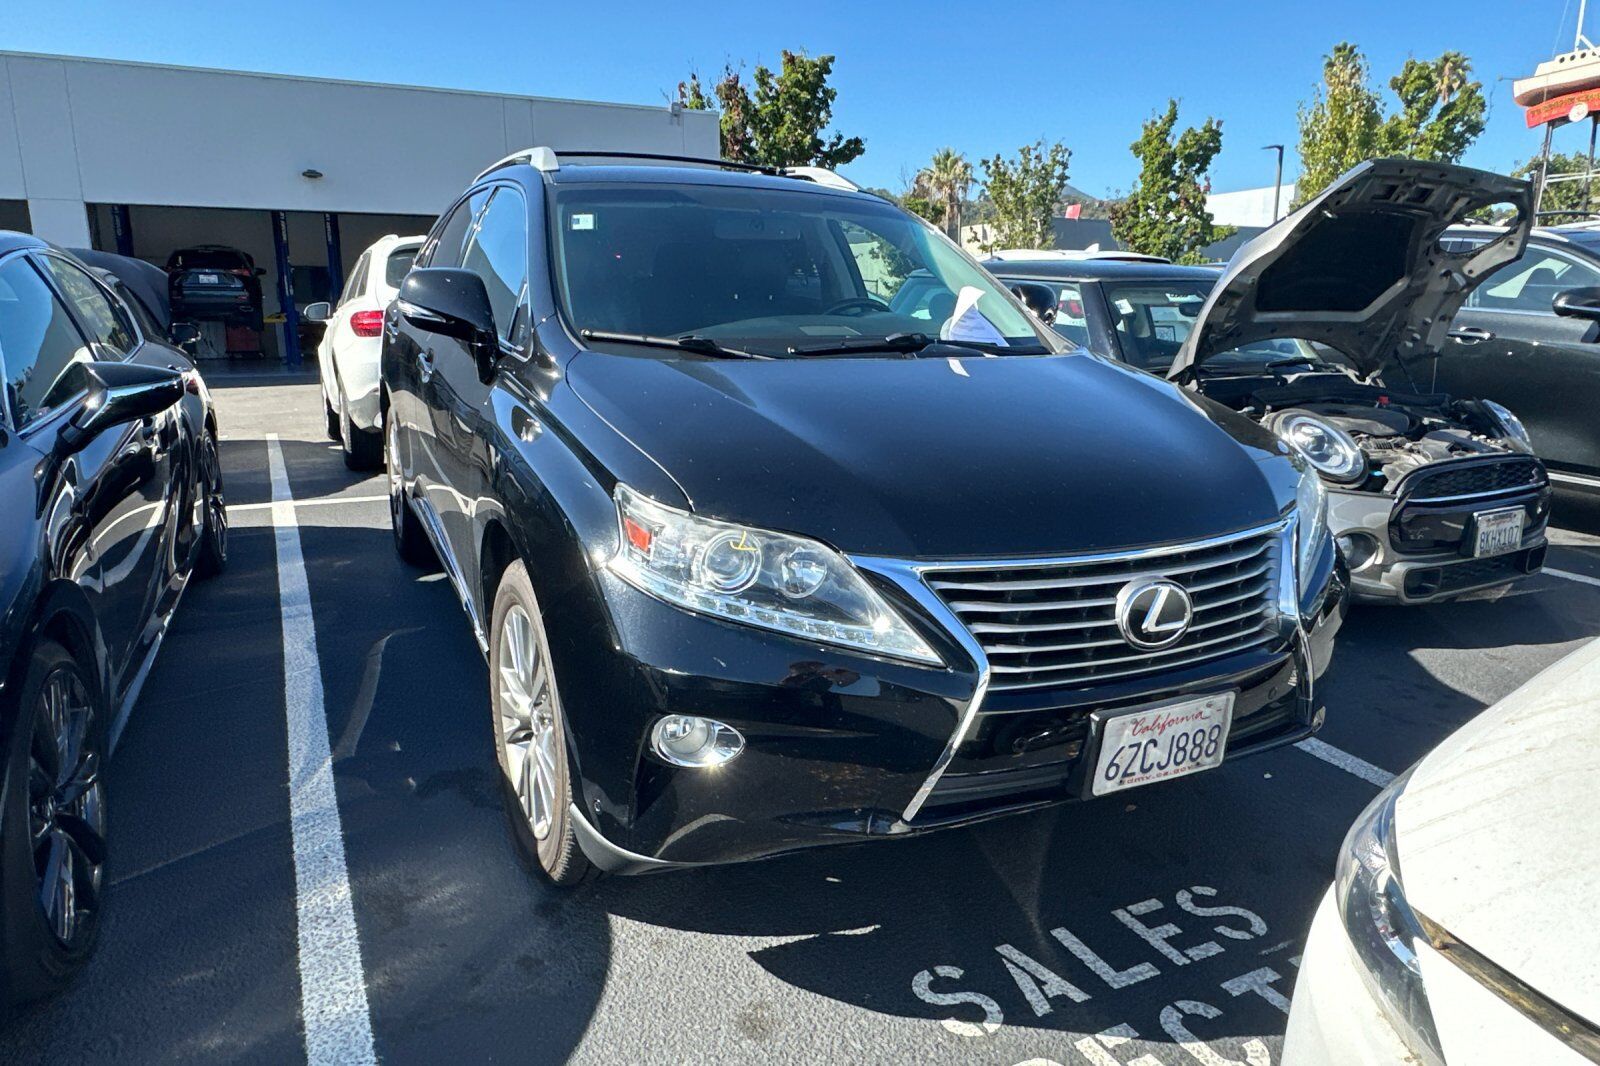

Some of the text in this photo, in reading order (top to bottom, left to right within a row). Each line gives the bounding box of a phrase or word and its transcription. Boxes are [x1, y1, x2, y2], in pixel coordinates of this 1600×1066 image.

[1132, 711, 1211, 736] California
[1105, 724, 1221, 781] 6ZCJ888
[911, 886, 1268, 1037] SALES
